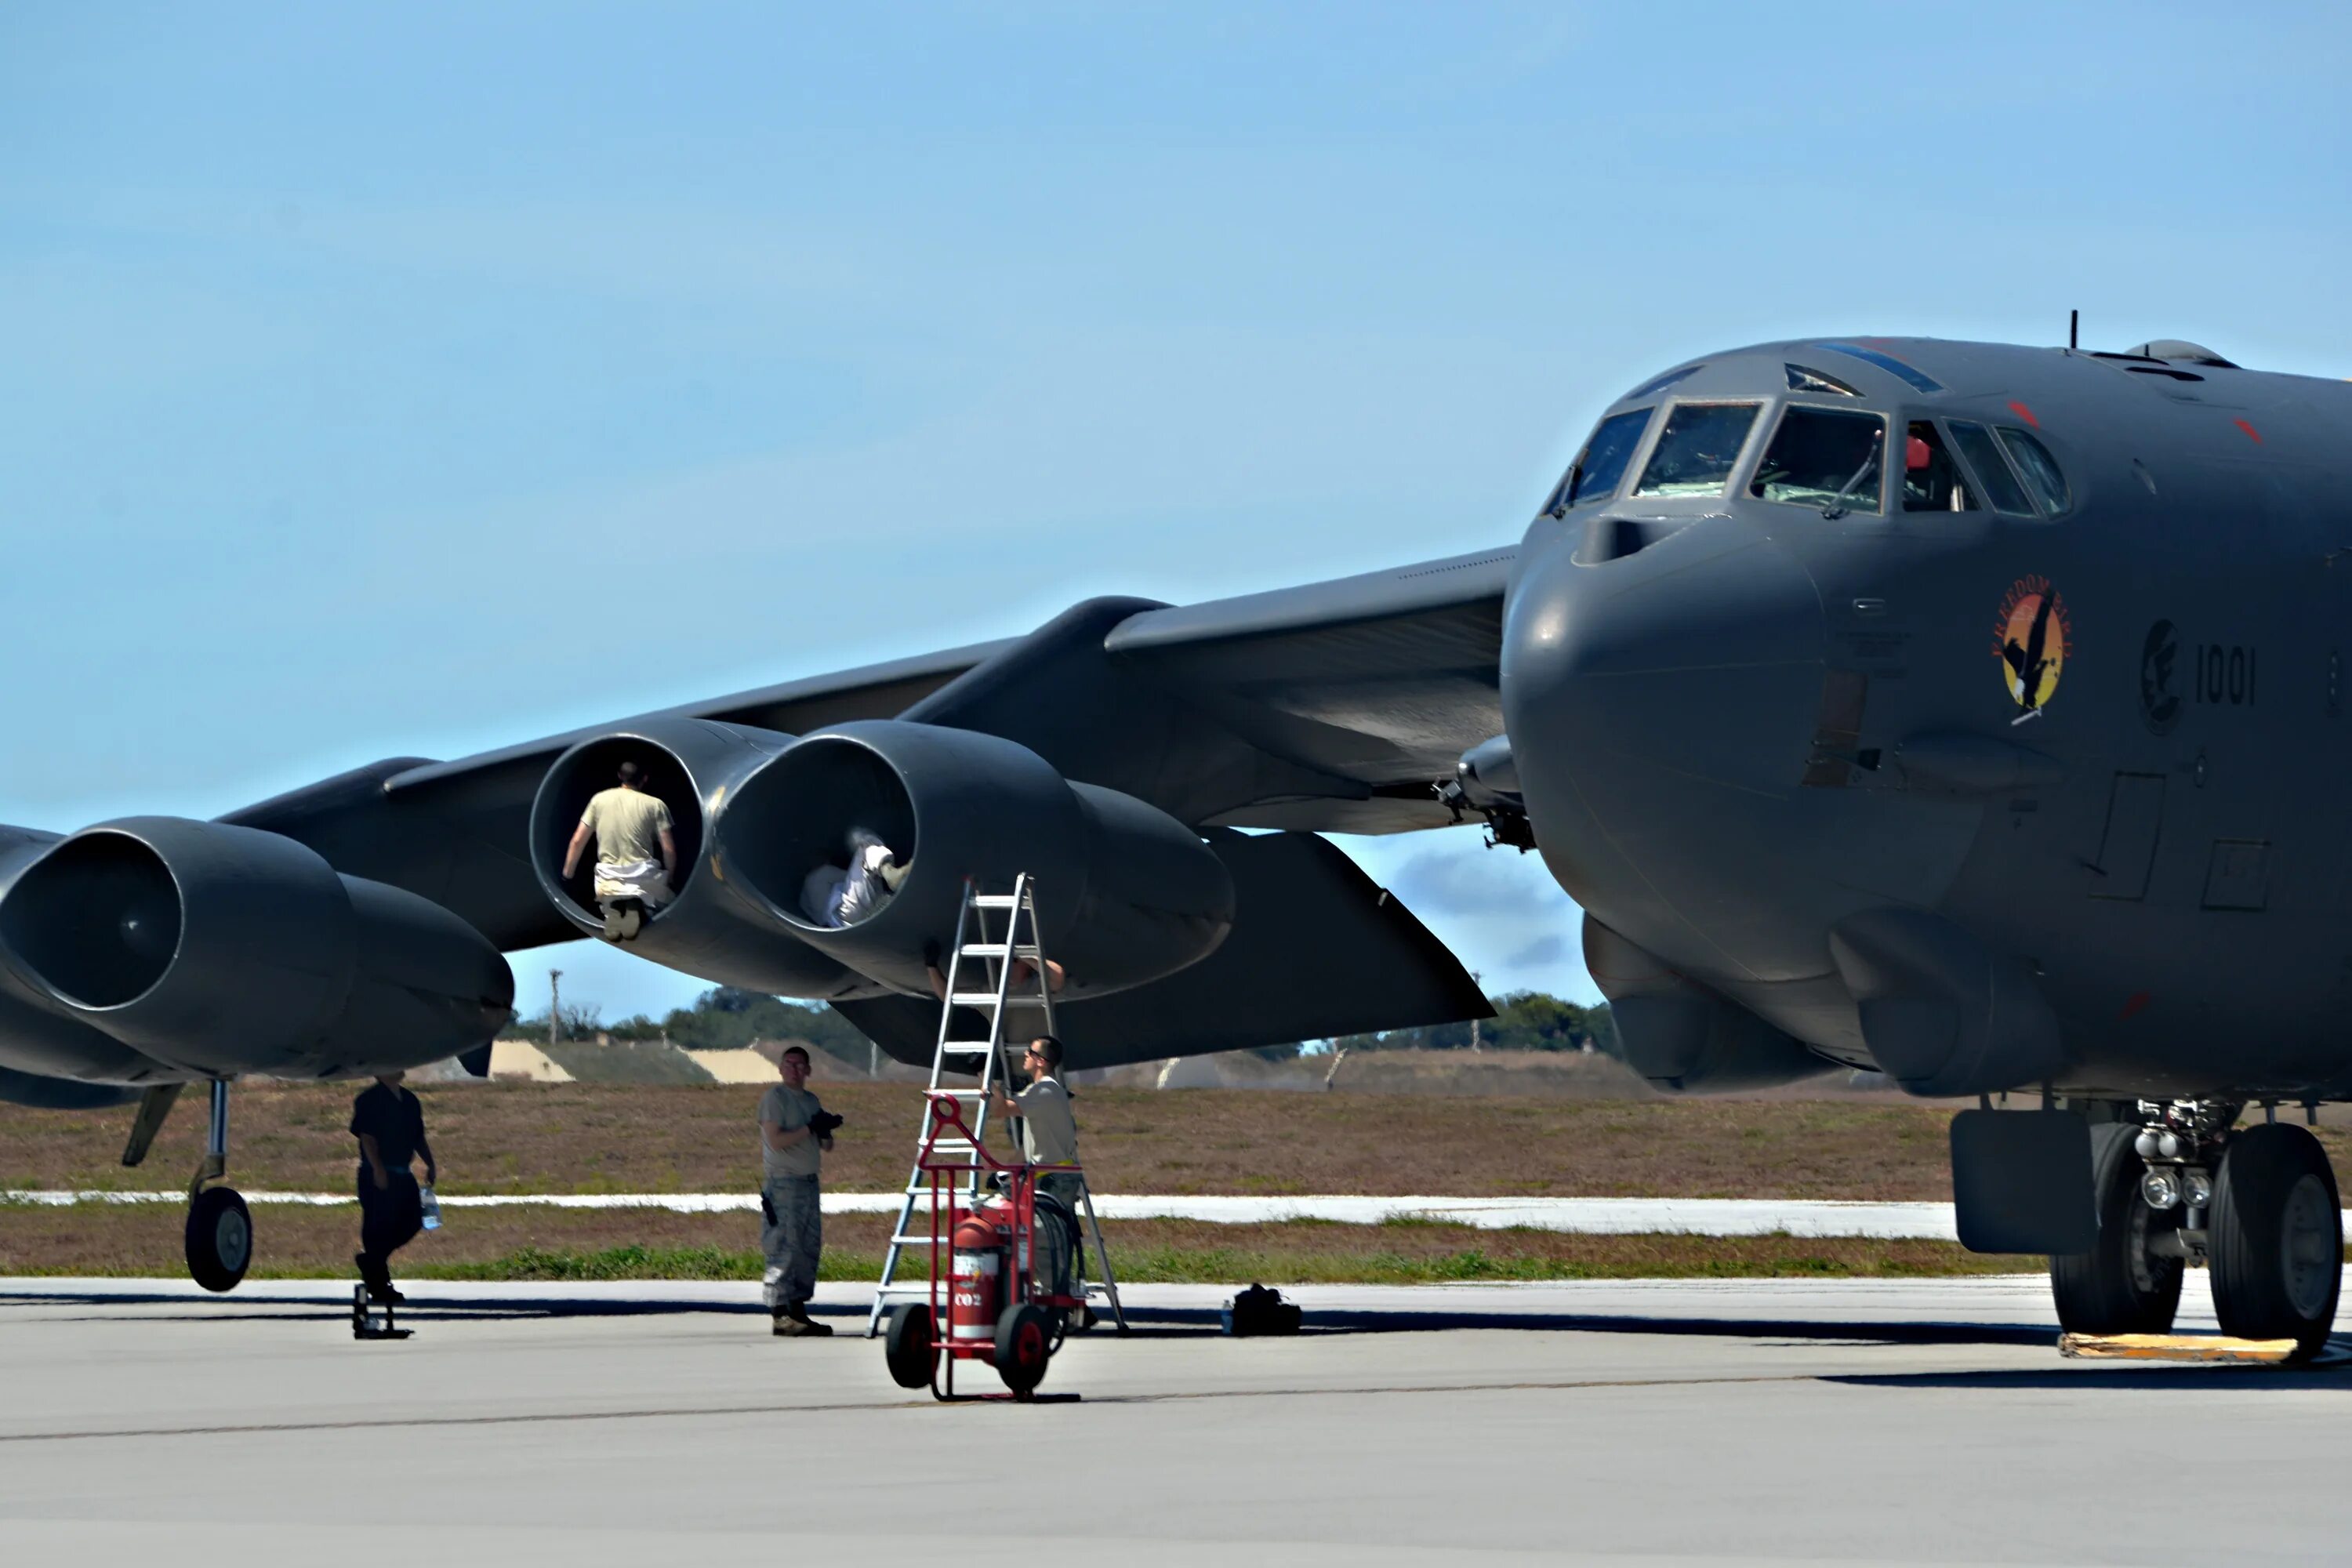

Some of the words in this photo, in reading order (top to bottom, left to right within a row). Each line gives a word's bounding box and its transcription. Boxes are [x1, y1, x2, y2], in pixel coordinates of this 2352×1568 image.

[1991, 574, 2050, 656] FREEDOM
[2196, 644, 2256, 706] 1001
[954, 1293, 982, 1307] CO2
